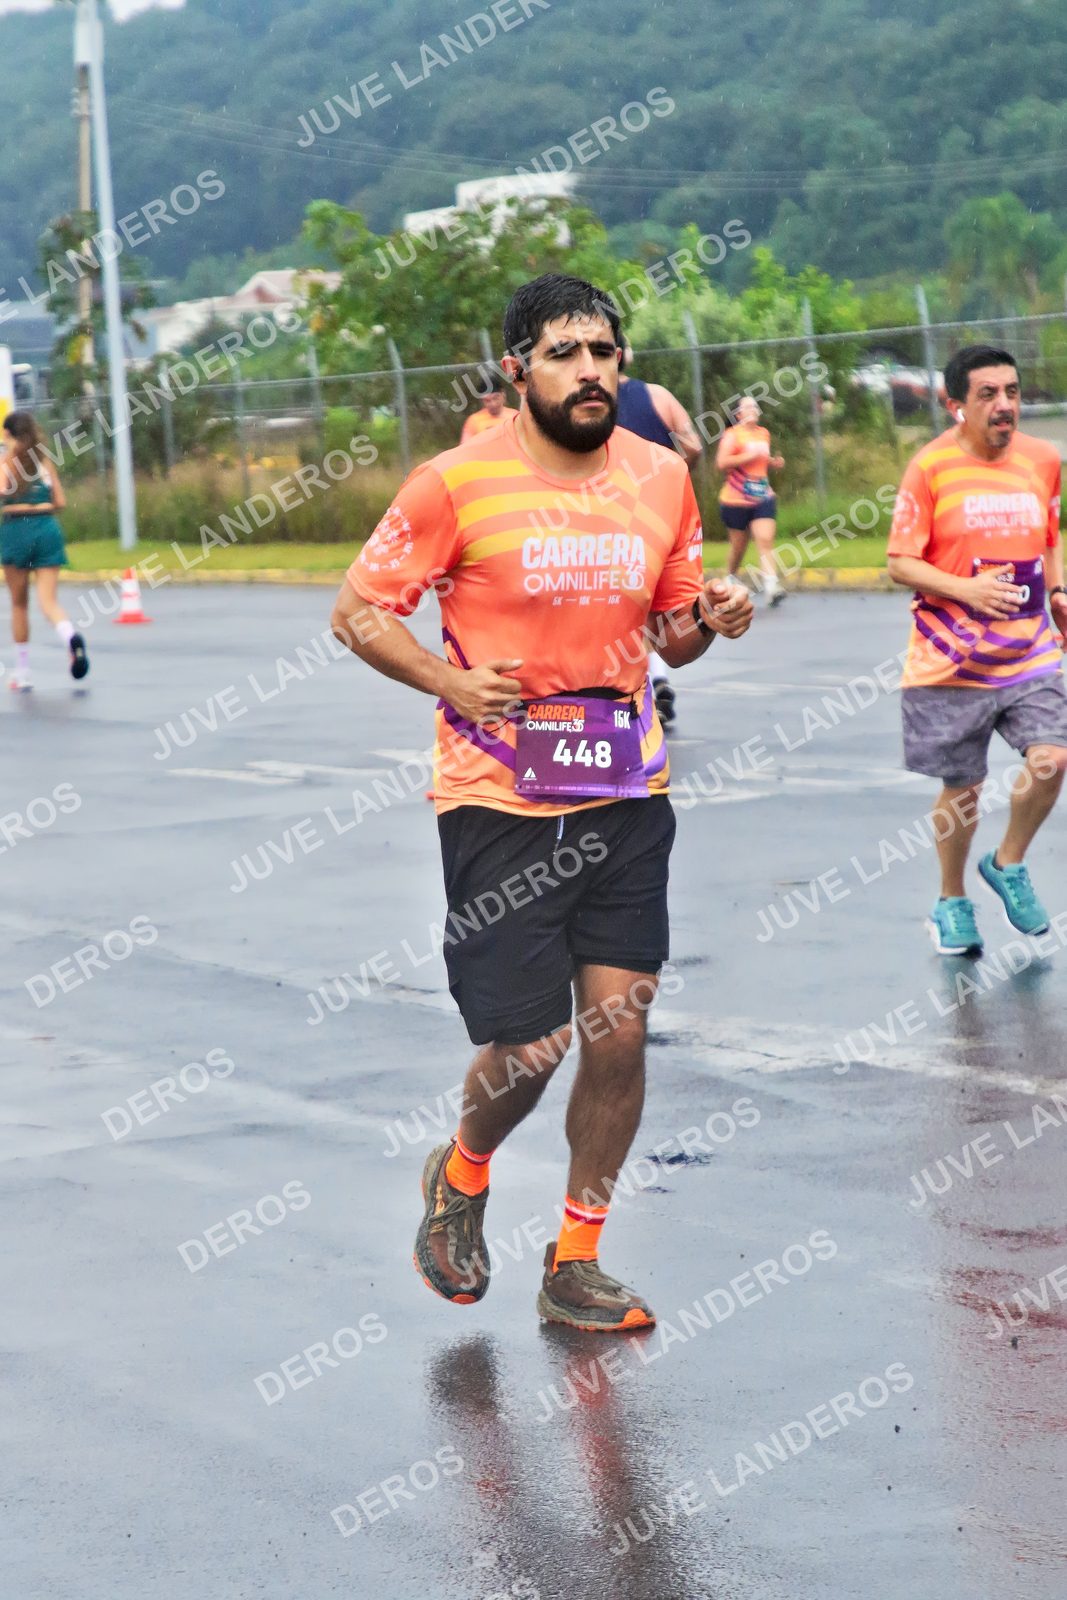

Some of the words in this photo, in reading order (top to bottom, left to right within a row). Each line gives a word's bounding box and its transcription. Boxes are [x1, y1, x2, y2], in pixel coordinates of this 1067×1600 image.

[522, 533, 646, 570] CARRERA
[524, 571, 621, 594] OMNILIFE
[527, 704, 585, 722] CARRERA
[613, 709, 631, 730] 15K
[526, 720, 571, 732] OMNILIFE
[552, 738, 612, 768] 448
